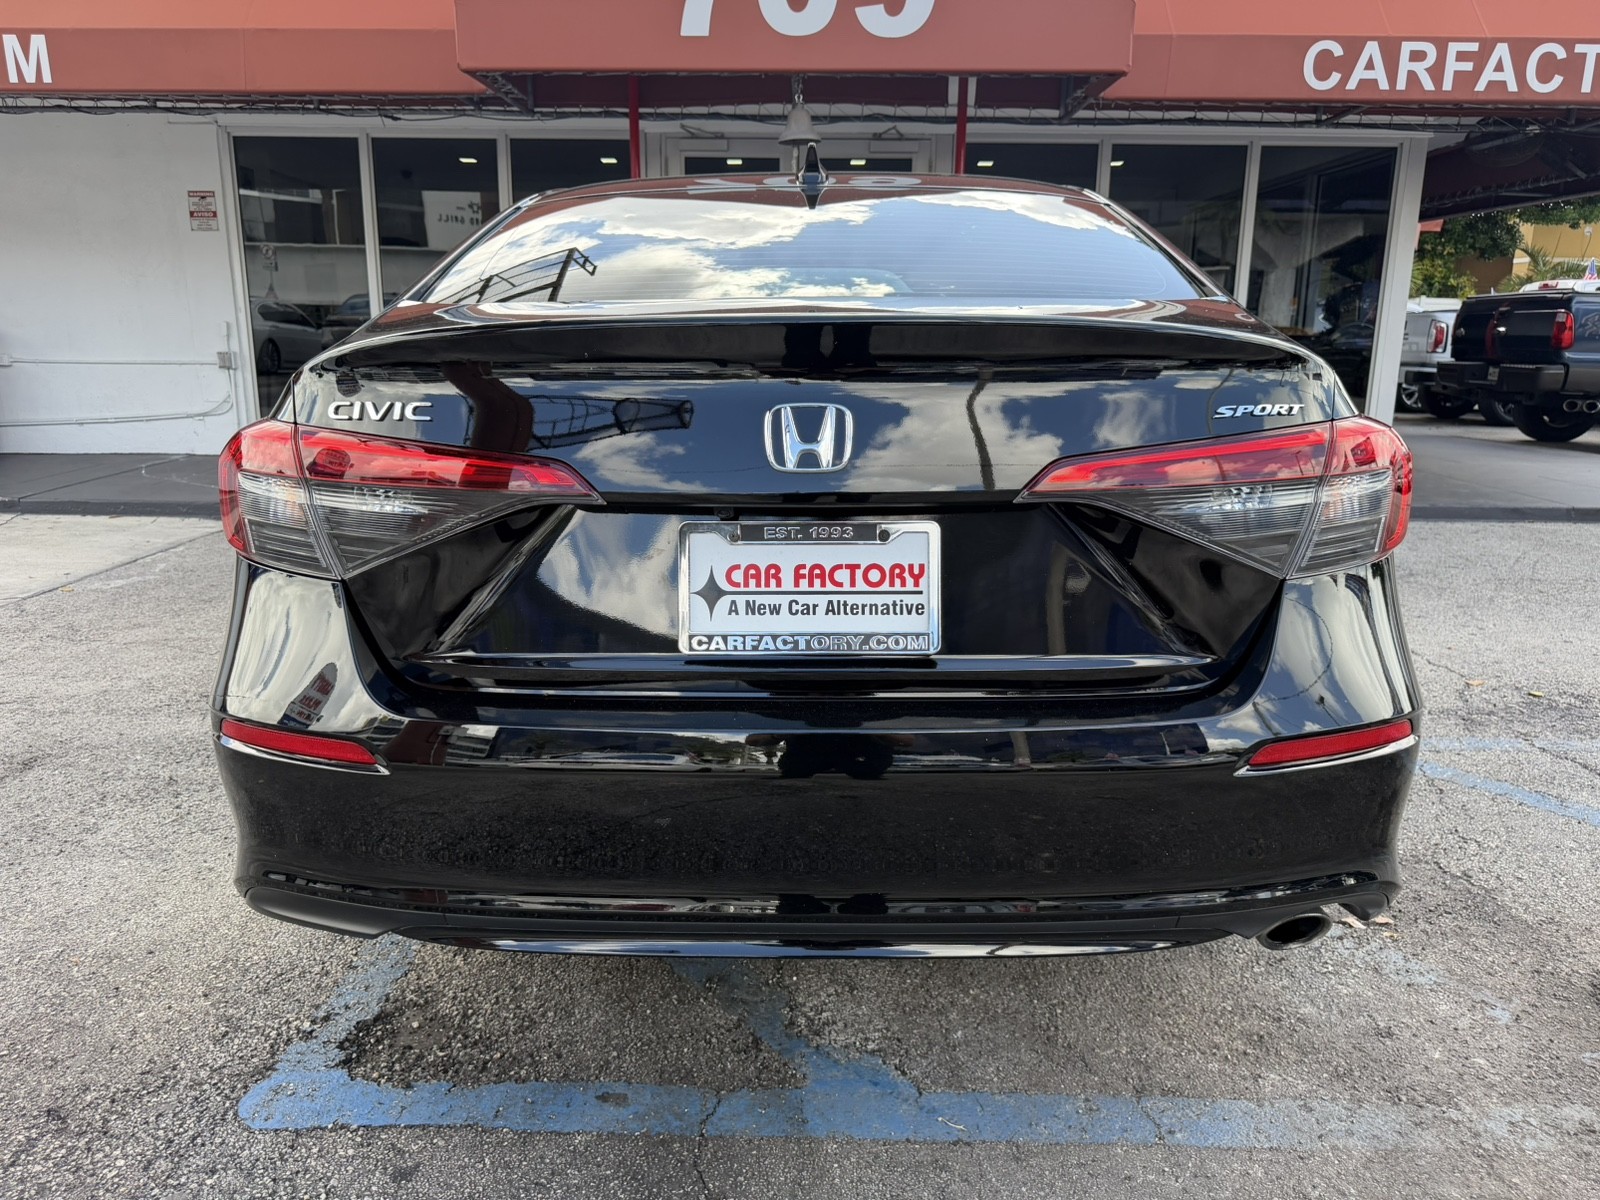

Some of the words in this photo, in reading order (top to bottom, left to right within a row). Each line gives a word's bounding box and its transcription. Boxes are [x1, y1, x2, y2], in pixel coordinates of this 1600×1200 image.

[2, 34, 53, 84] M
[1303, 39, 1600, 94] CARFACT
[327, 401, 433, 421] CIVIC
[1212, 403, 1305, 419] SPORT
[763, 526, 803, 539] EST.
[809, 526, 854, 538] 1993
[725, 563, 782, 588] CAR
[793, 563, 926, 588] FACTORY
[727, 599, 740, 616] A
[745, 599, 782, 616] New
[788, 599, 819, 616] Car
[824, 599, 926, 616] Alternative
[690, 635, 929, 651] CARFACTORY.COM
